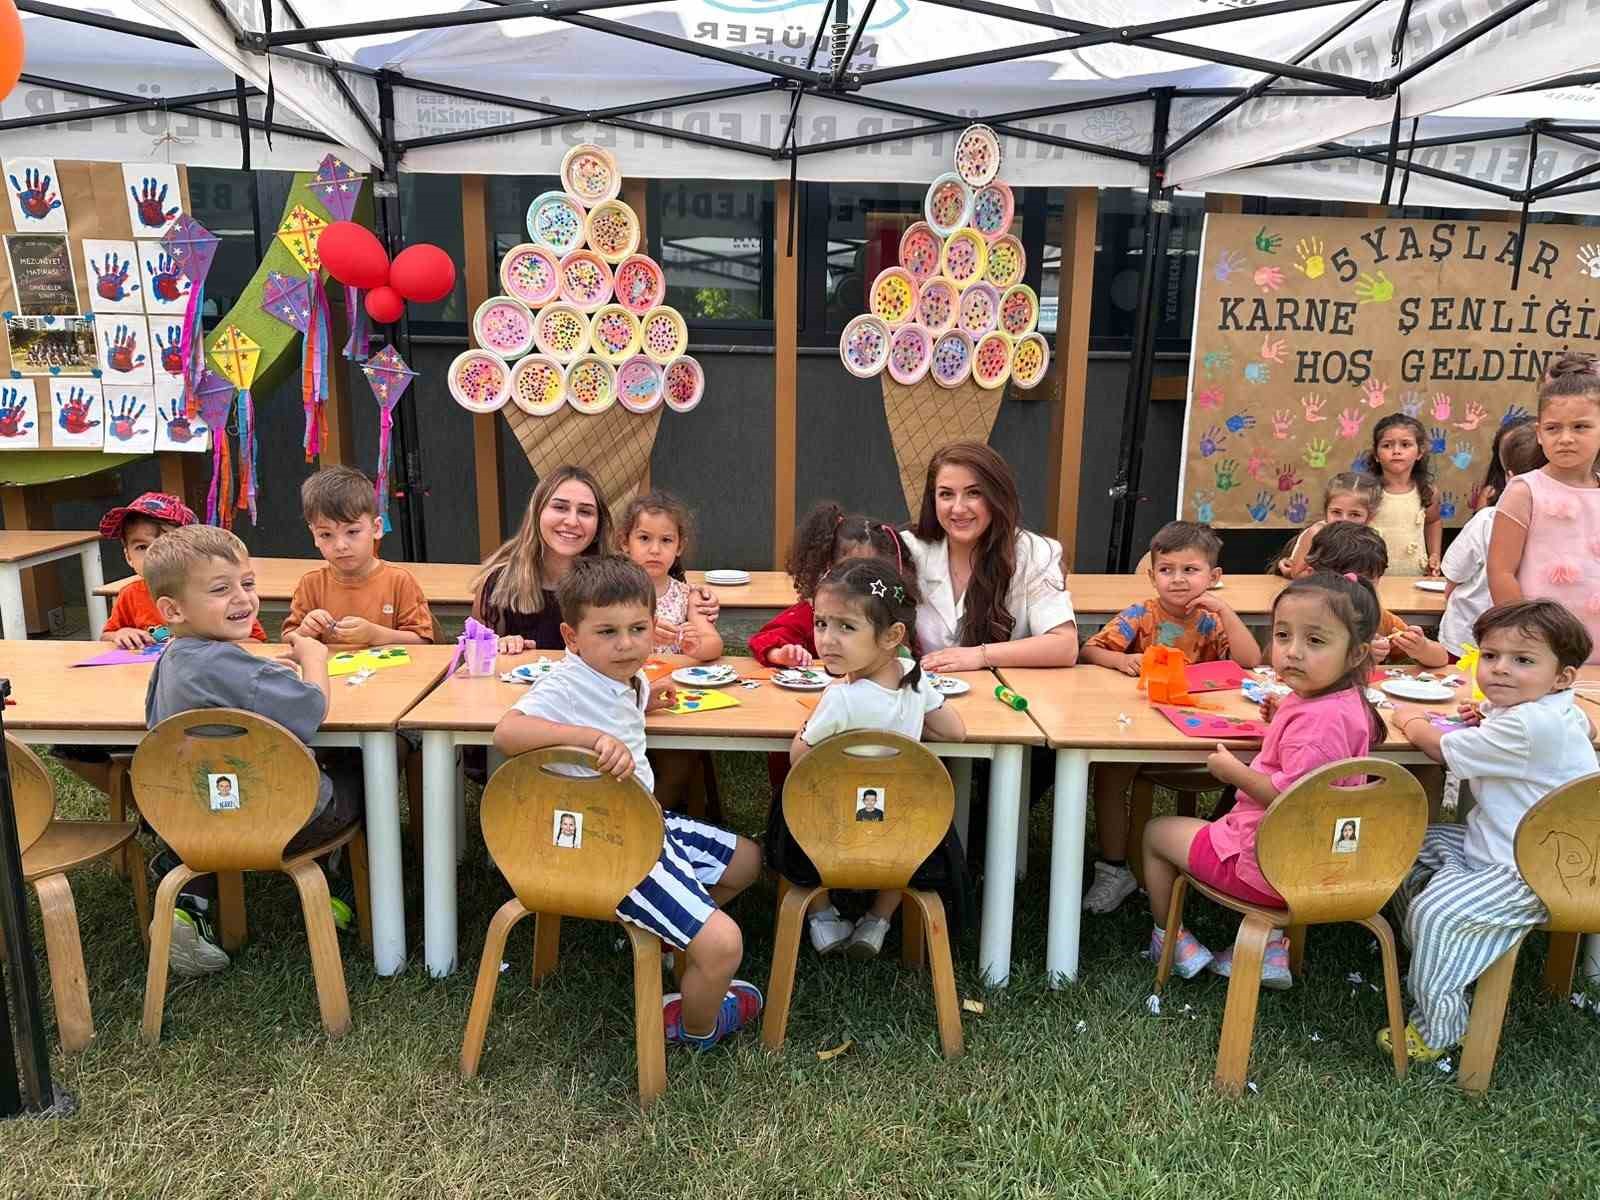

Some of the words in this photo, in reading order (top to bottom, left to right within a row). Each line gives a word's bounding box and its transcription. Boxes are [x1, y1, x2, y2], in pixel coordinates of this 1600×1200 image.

[1330, 247, 1359, 283] 5
[1360, 223, 1560, 279] YAŞLAR
[1218, 297, 1358, 335] KARNE
[1398, 293, 1600, 340] ŞENLİĞİ
[1294, 349, 1374, 387] HOŞ
[1401, 342, 1596, 383] GELDİN
